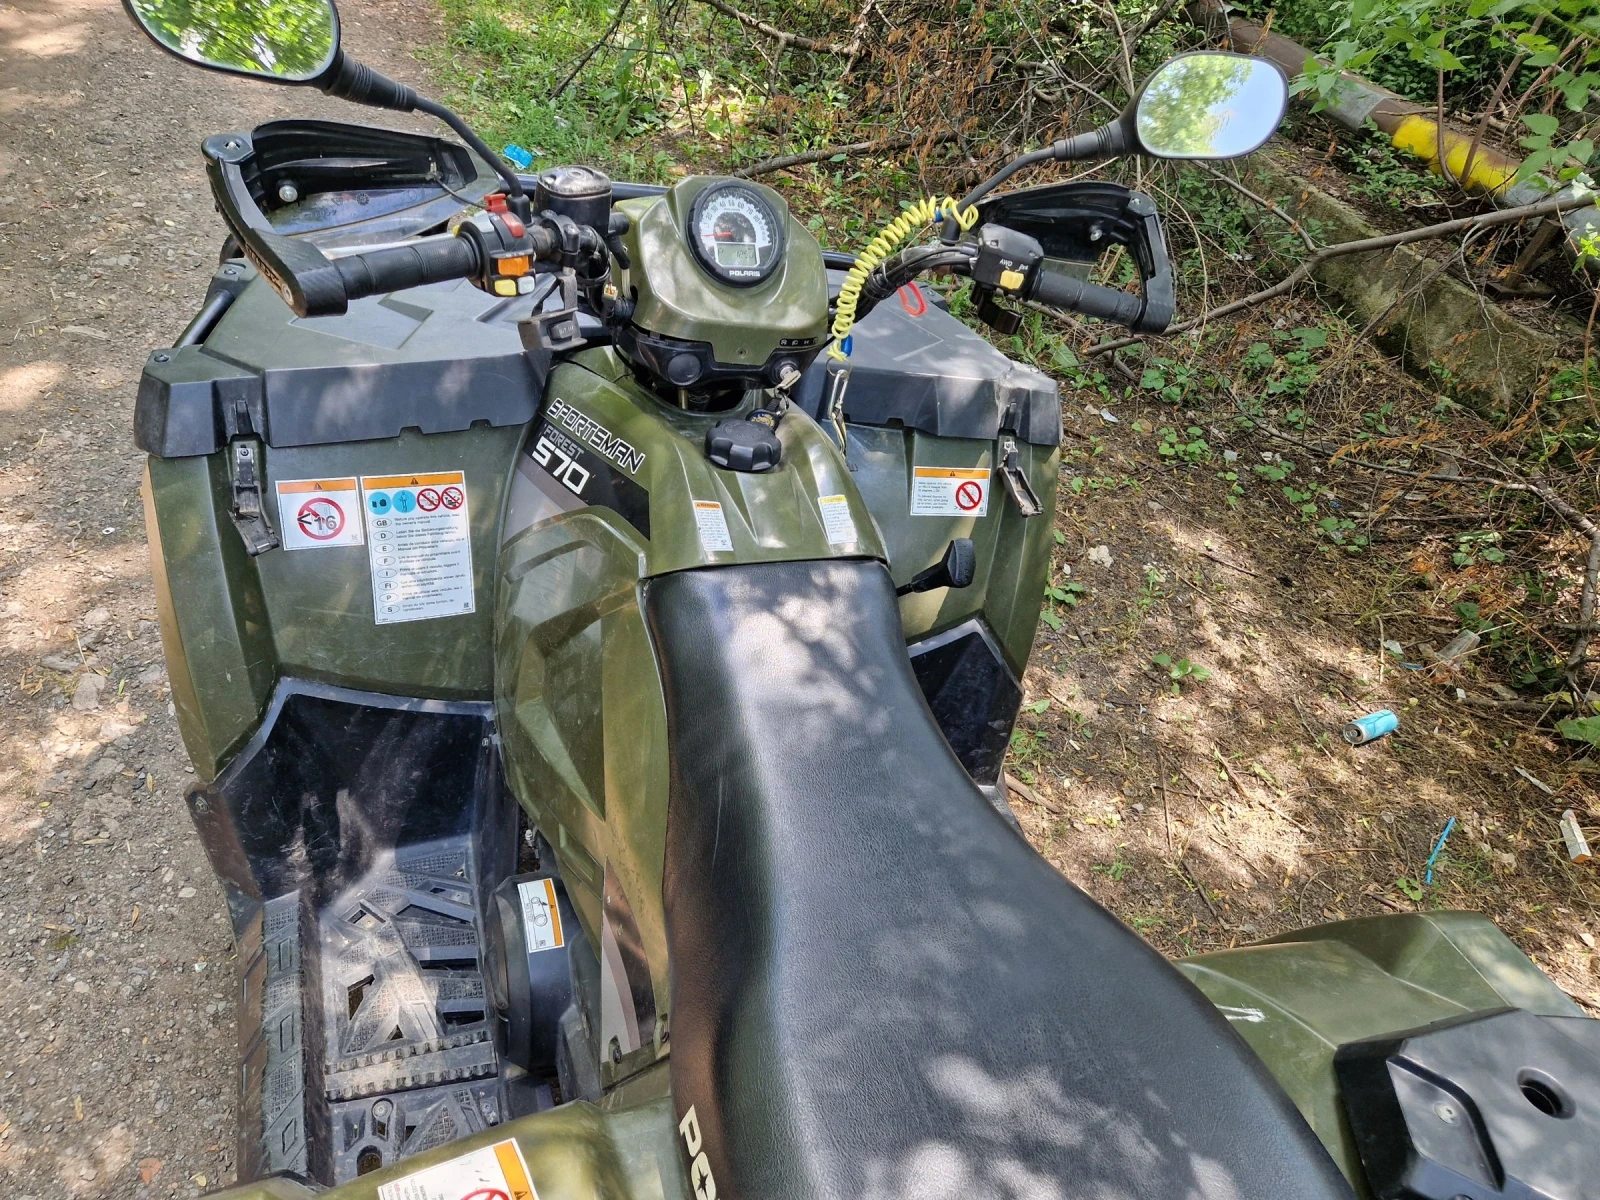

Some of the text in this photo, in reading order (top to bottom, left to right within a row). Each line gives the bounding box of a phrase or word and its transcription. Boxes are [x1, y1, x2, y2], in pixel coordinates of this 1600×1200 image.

[999, 258, 1013, 267] AWD
[543, 425, 585, 460] FOREST
[546, 397, 646, 475] SPORTSMAN
[531, 435, 590, 495] 570
